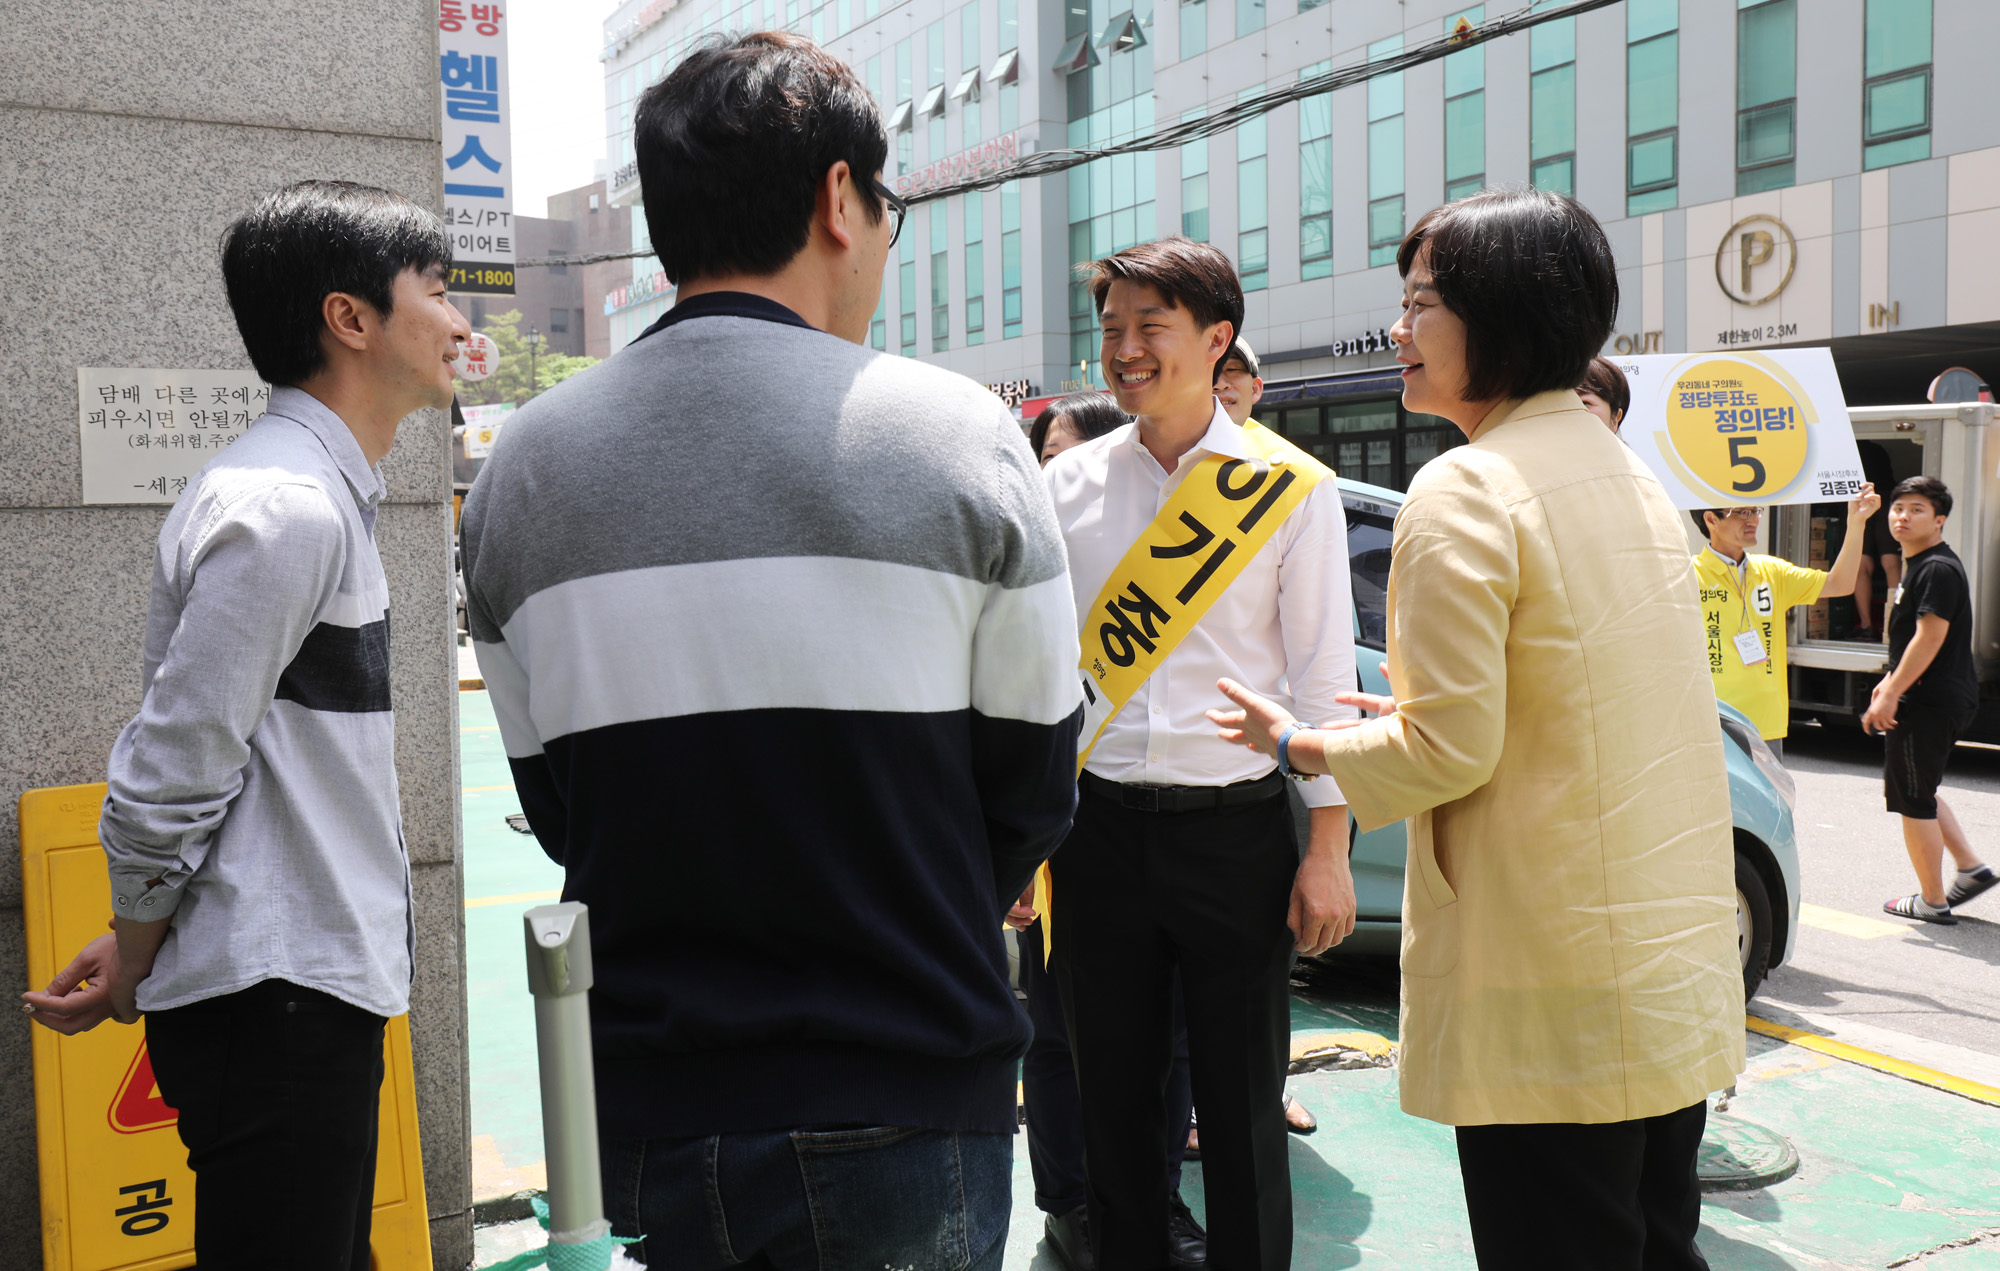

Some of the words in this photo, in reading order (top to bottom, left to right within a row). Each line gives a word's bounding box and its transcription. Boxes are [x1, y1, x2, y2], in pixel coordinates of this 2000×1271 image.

[441, 50, 504, 198] 헬스
[450, 233, 512, 253] 이어트
[1741, 231, 1775, 294] P
[1868, 300, 1900, 328] IN
[1614, 330, 1663, 356] OUT
[1717, 328, 1762, 344] 제한높이
[1766, 323, 1797, 340] 2.3M
[98, 384, 140, 405] 담배
[155, 385, 198, 405] 다른
[210, 386, 270, 406] 곳에서
[1679, 390, 1759, 409] 정당투표도
[87, 409, 176, 429] 피우시면
[189, 409, 265, 430] 안될까
[1714, 407, 1795, 433] 정의당!
[1728, 436, 1767, 492] 5
[1100, 457, 1297, 667] 이기중
[1757, 587, 1771, 612] 5
[1706, 610, 1723, 667] 서울시장
[114, 1178, 173, 1237] 공
